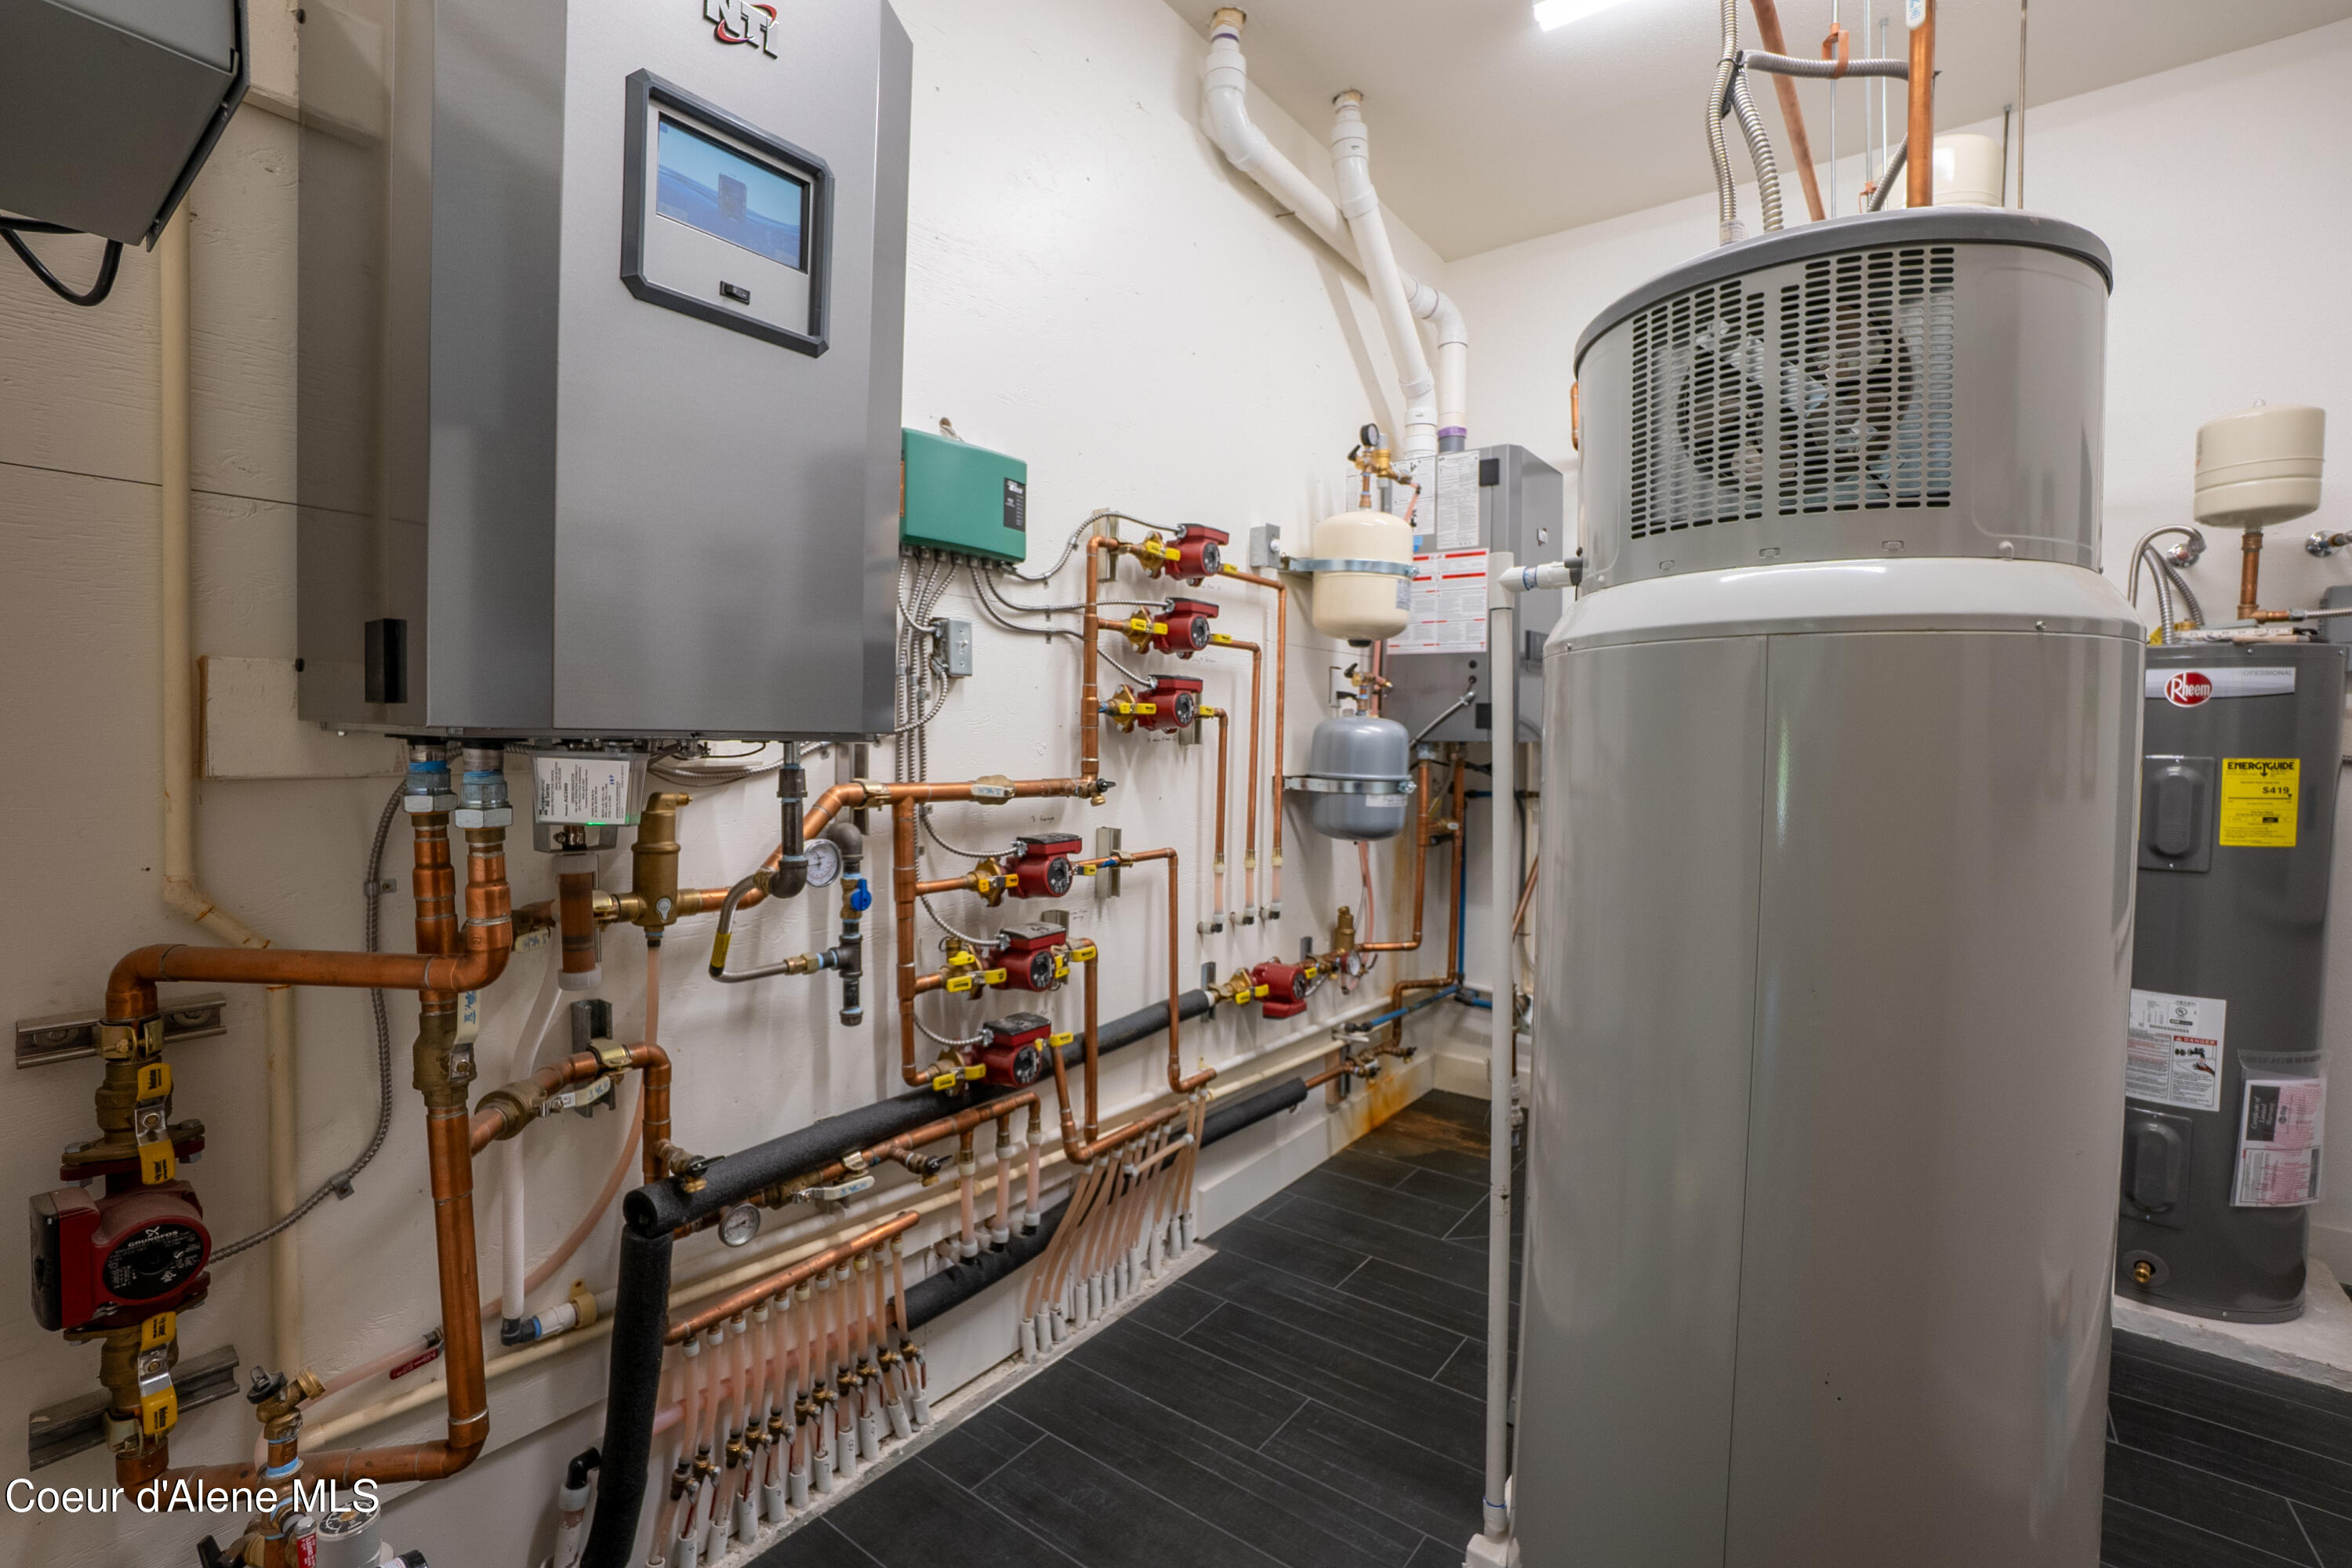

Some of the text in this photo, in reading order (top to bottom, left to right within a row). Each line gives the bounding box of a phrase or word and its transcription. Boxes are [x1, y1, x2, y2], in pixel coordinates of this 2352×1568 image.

[703, 0, 779, 60] NTI
[2170, 672, 2211, 702] Rheem
[2227, 761, 2295, 773] ENERGYGUIDE
[127, 1229, 179, 1248] GRUNDFOS
